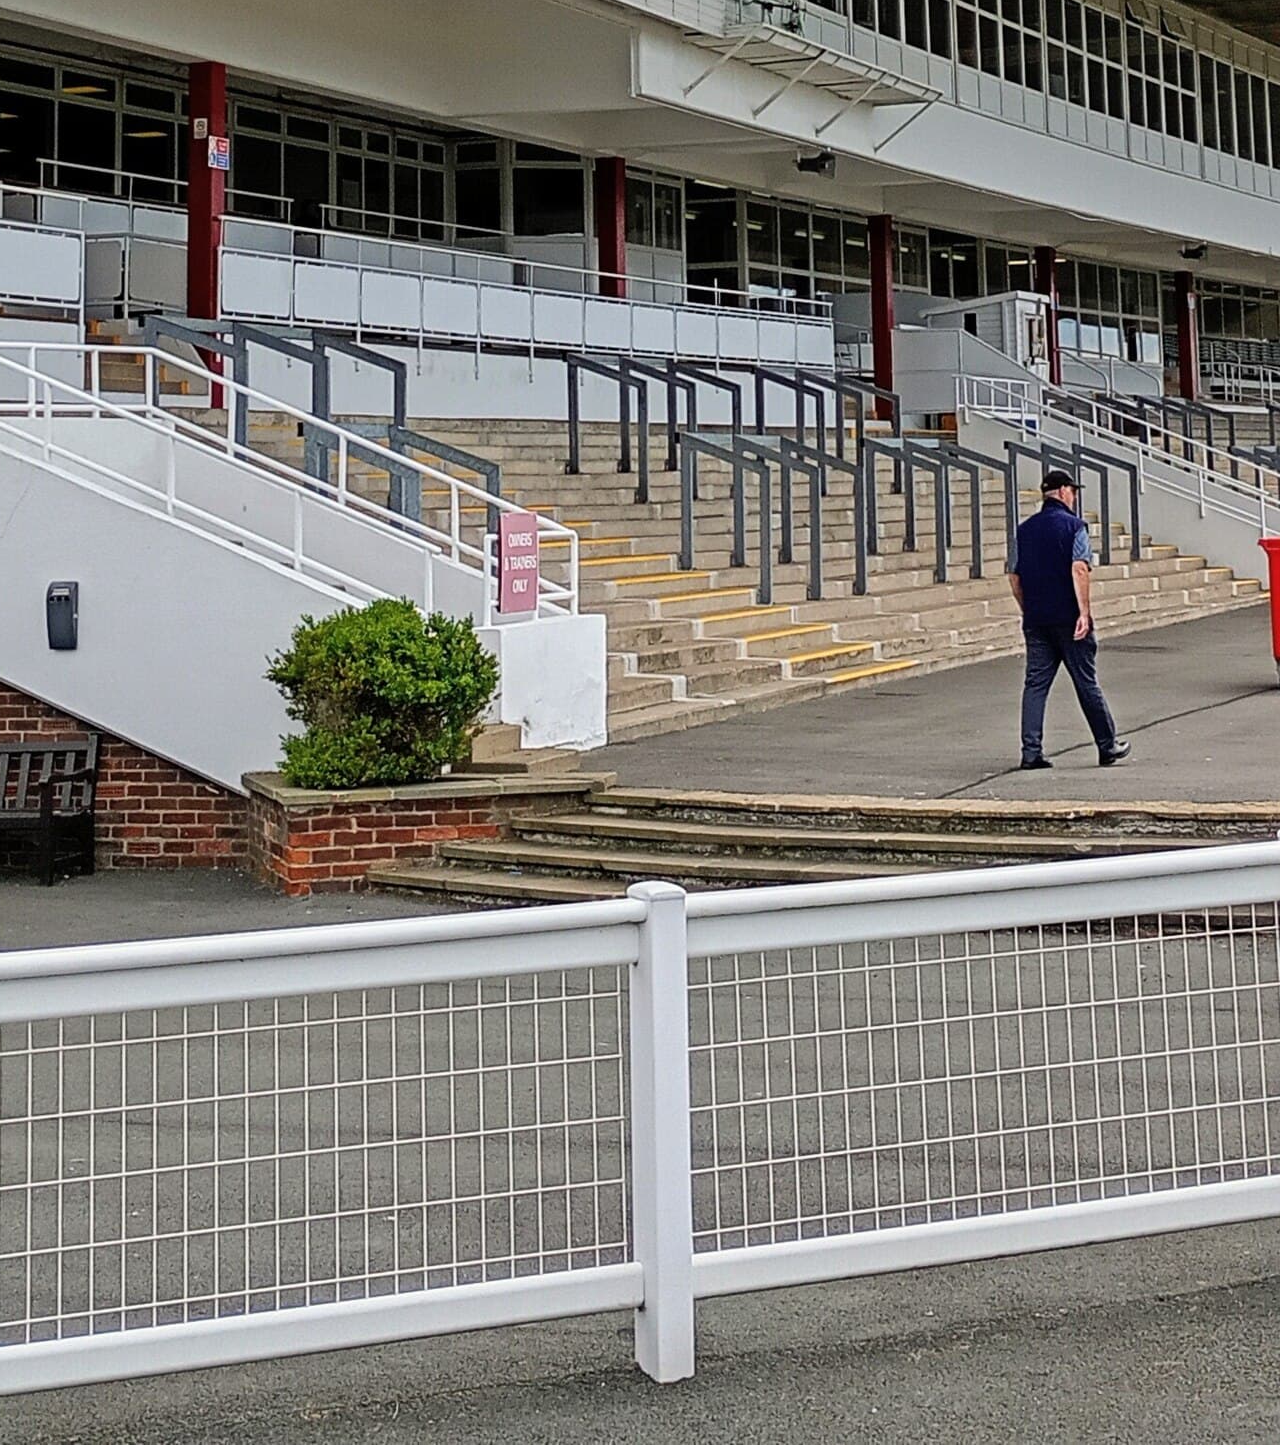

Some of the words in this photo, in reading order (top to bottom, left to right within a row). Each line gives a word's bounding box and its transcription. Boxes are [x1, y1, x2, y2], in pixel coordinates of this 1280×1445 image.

[508, 533, 533, 548] OWNERS
[510, 555, 536, 570] TRAINERS
[512, 579, 528, 593] ONLY
